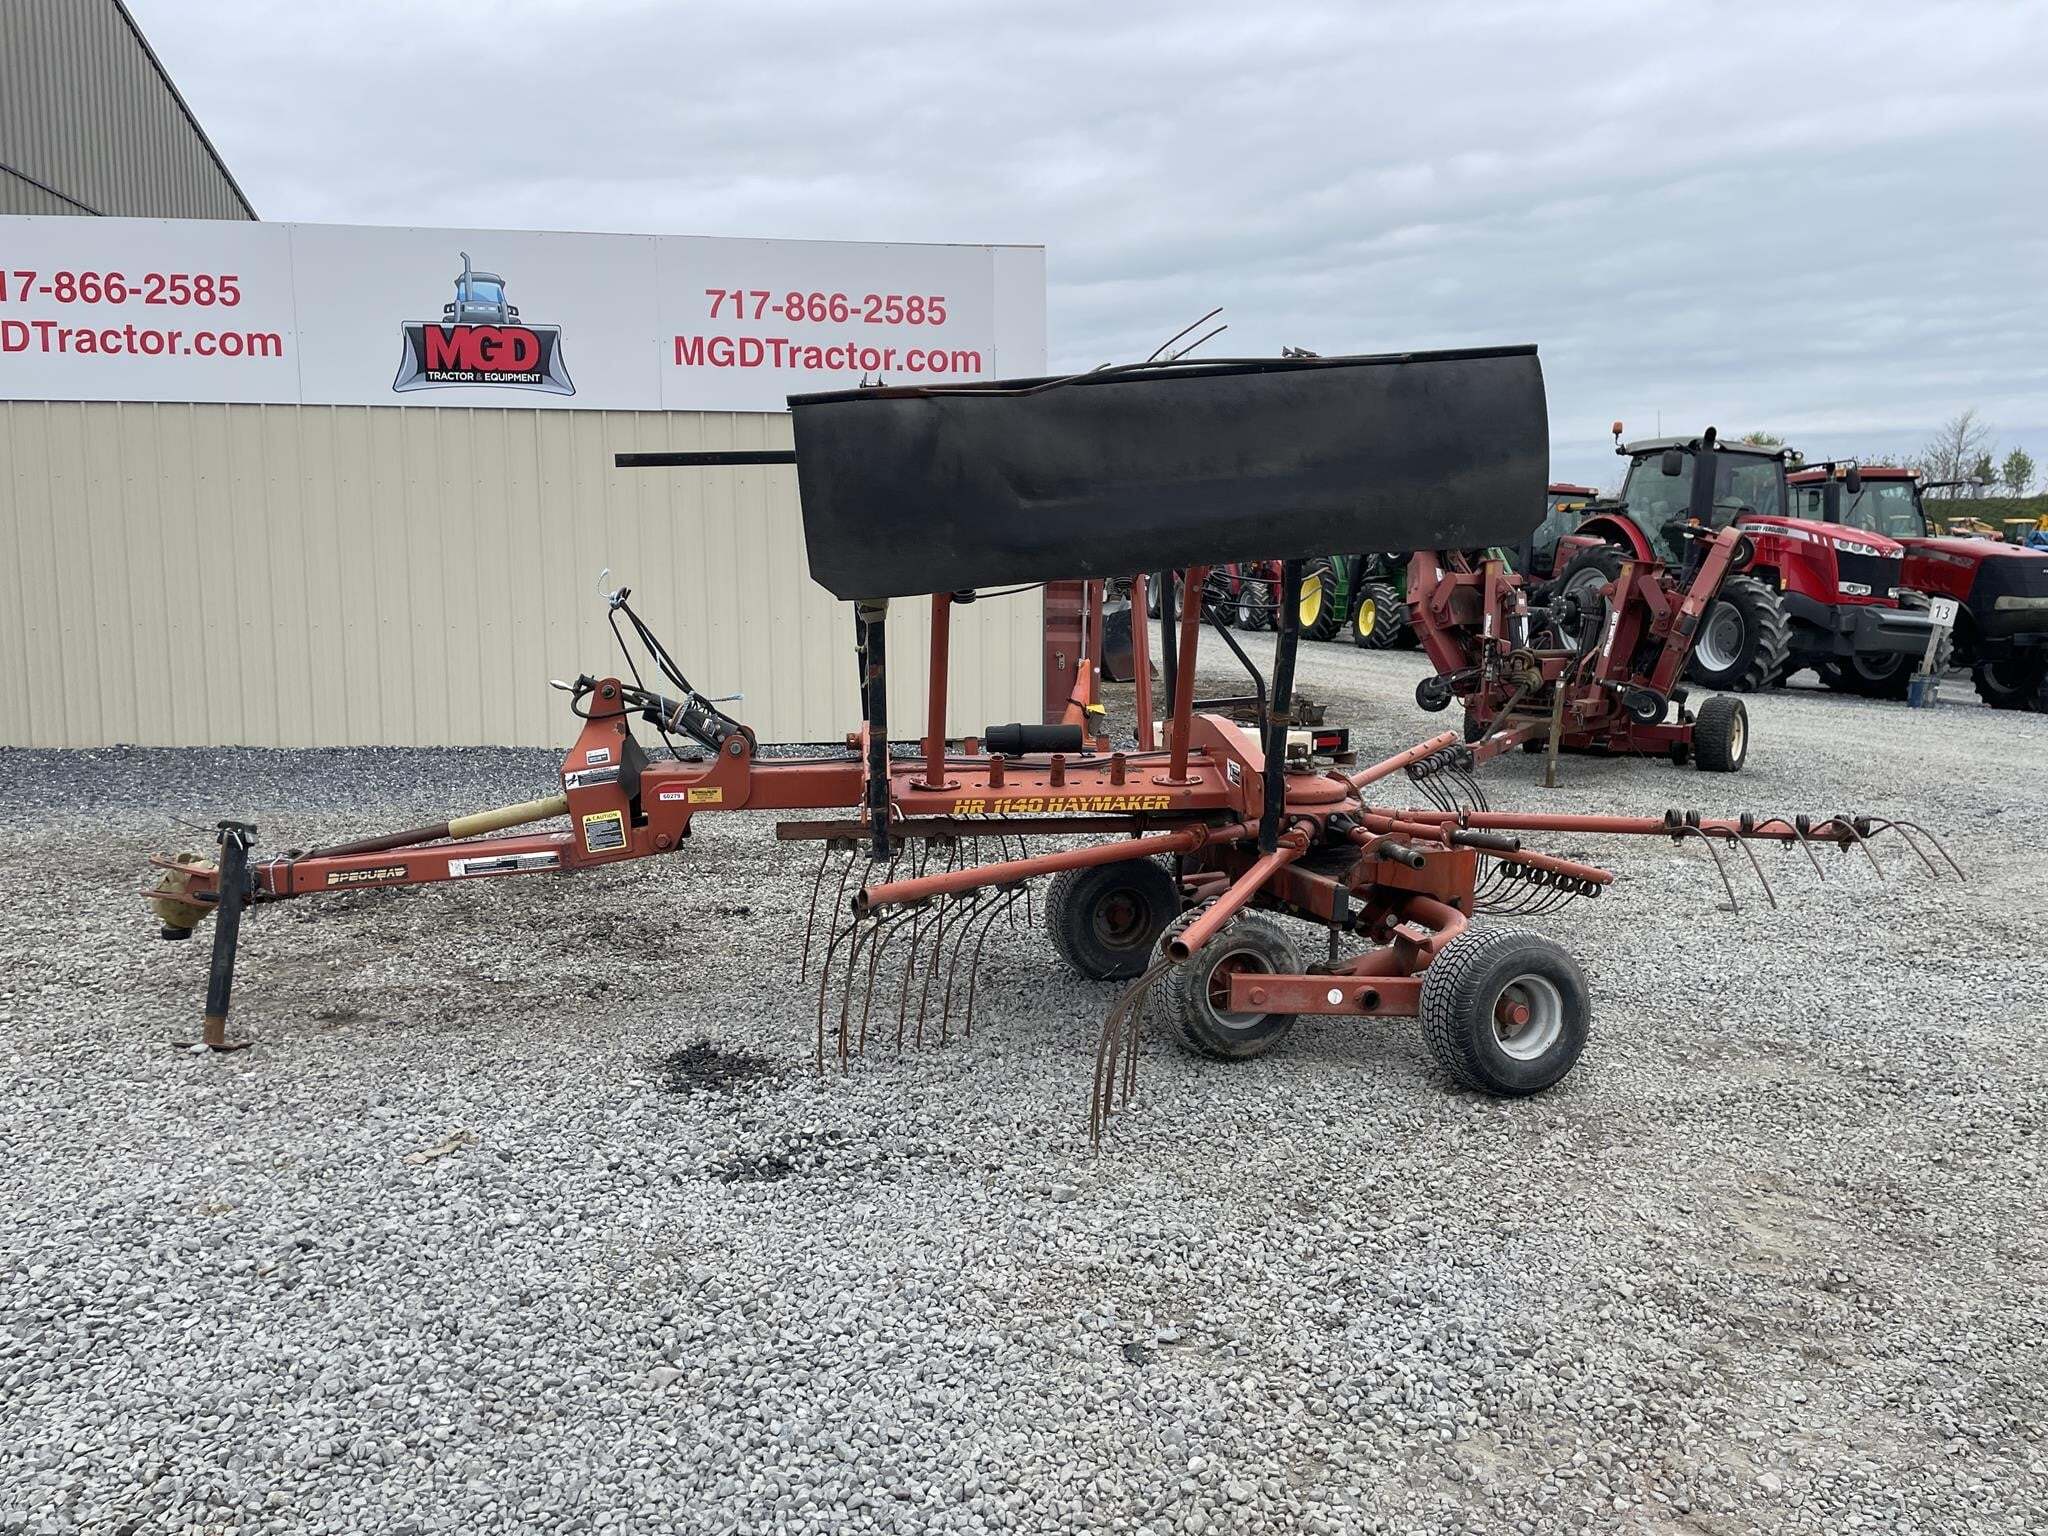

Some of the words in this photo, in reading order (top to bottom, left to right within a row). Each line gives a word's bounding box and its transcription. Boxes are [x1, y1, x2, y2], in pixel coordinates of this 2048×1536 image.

[704, 288, 947, 326] 717-866-2585
[423, 324, 541, 371] MGD
[673, 335, 982, 374] MGDTractor.com
[428, 371, 474, 381] TRACTOR
[484, 372, 541, 382] EQUIPMENT
[1935, 605, 1950, 620] 13
[953, 799, 986, 814] HR
[993, 798, 1044, 813] 1140
[1047, 795, 1171, 812] HAYMAKER
[592, 813, 617, 821] CAUTION
